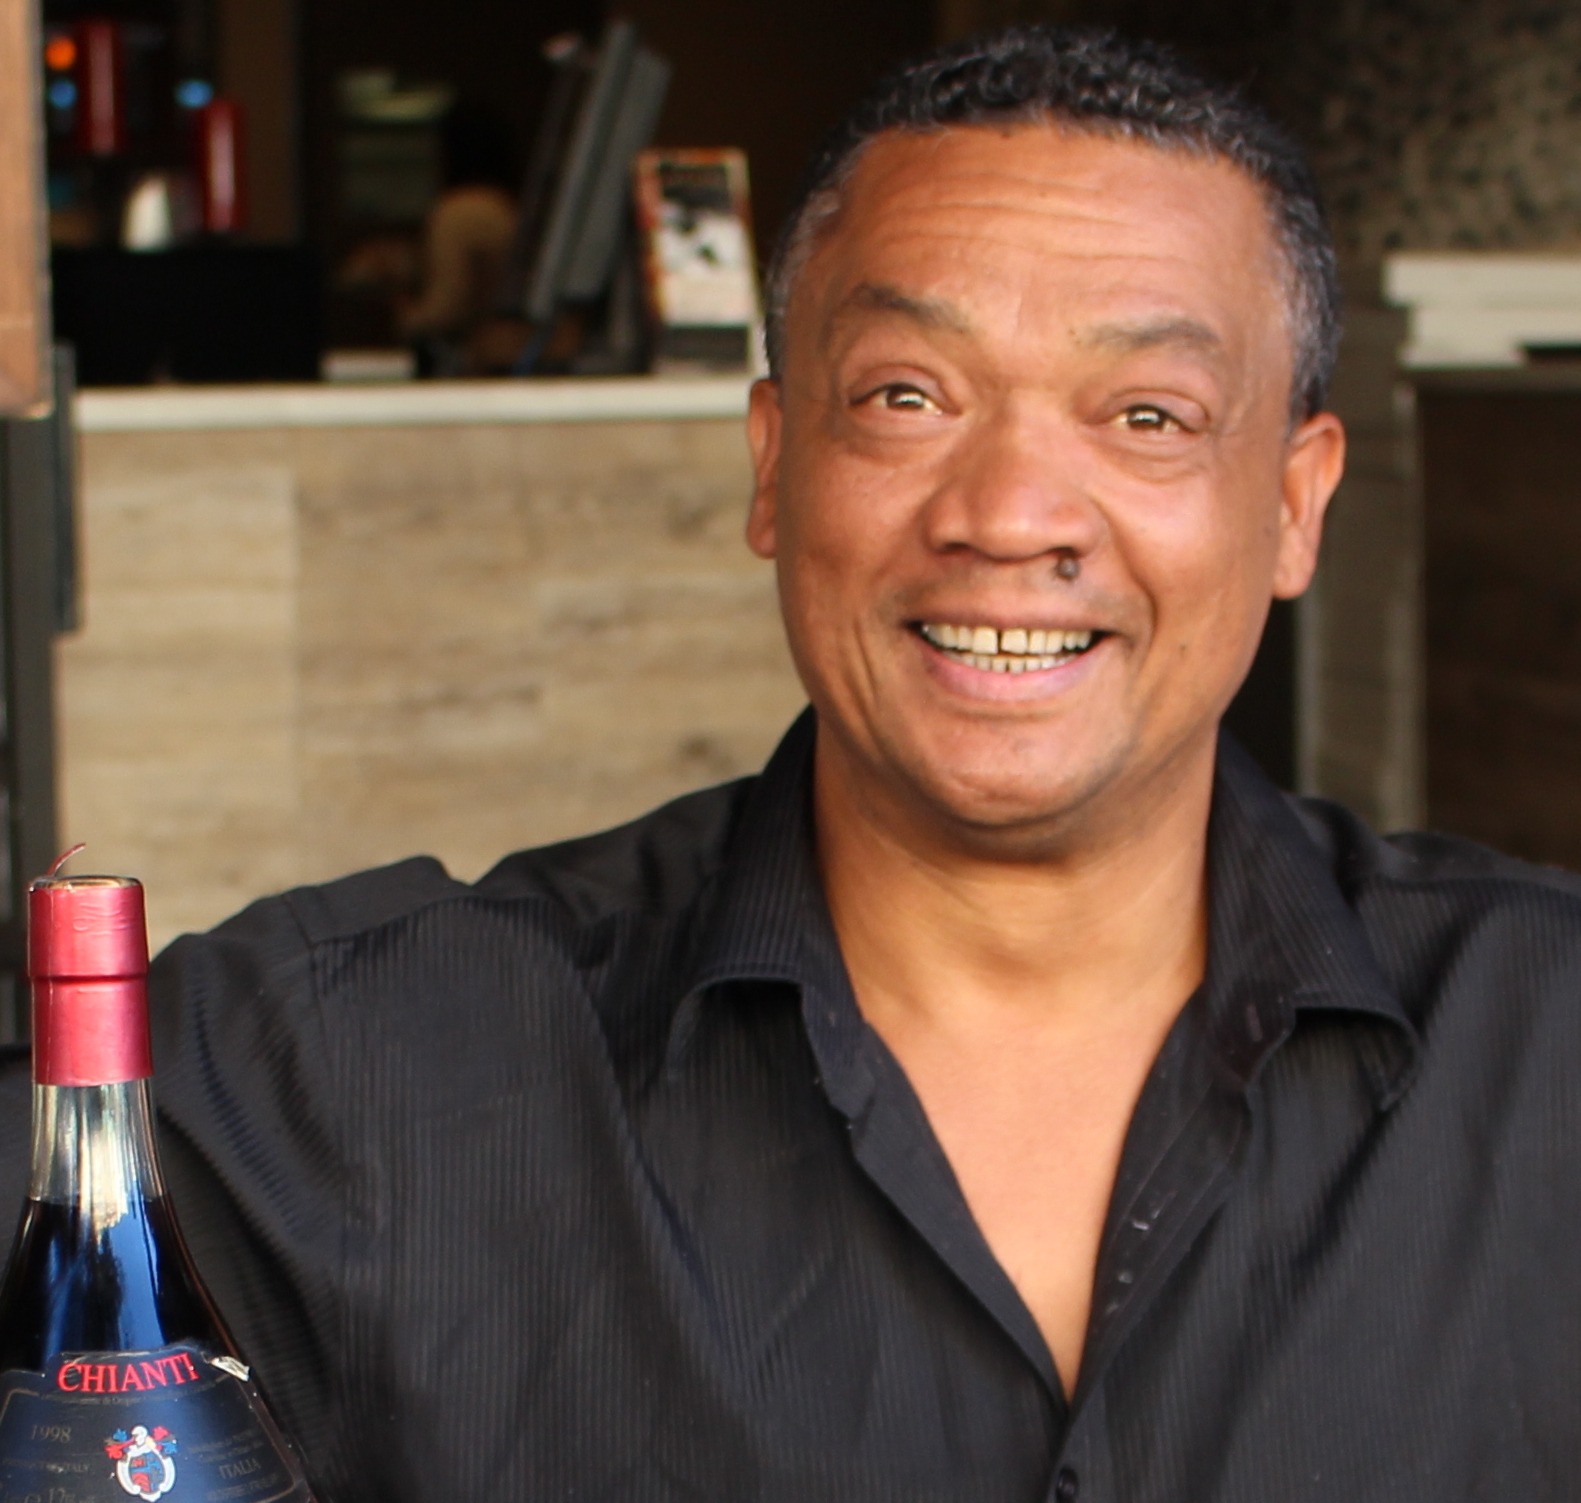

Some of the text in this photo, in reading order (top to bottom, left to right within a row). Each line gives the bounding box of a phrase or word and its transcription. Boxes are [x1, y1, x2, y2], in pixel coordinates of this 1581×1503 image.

[56, 1352, 200, 1394] CHIANTI
[29, 1423, 73, 1444] 1998
[219, 1457, 262, 1480] ITALIA
